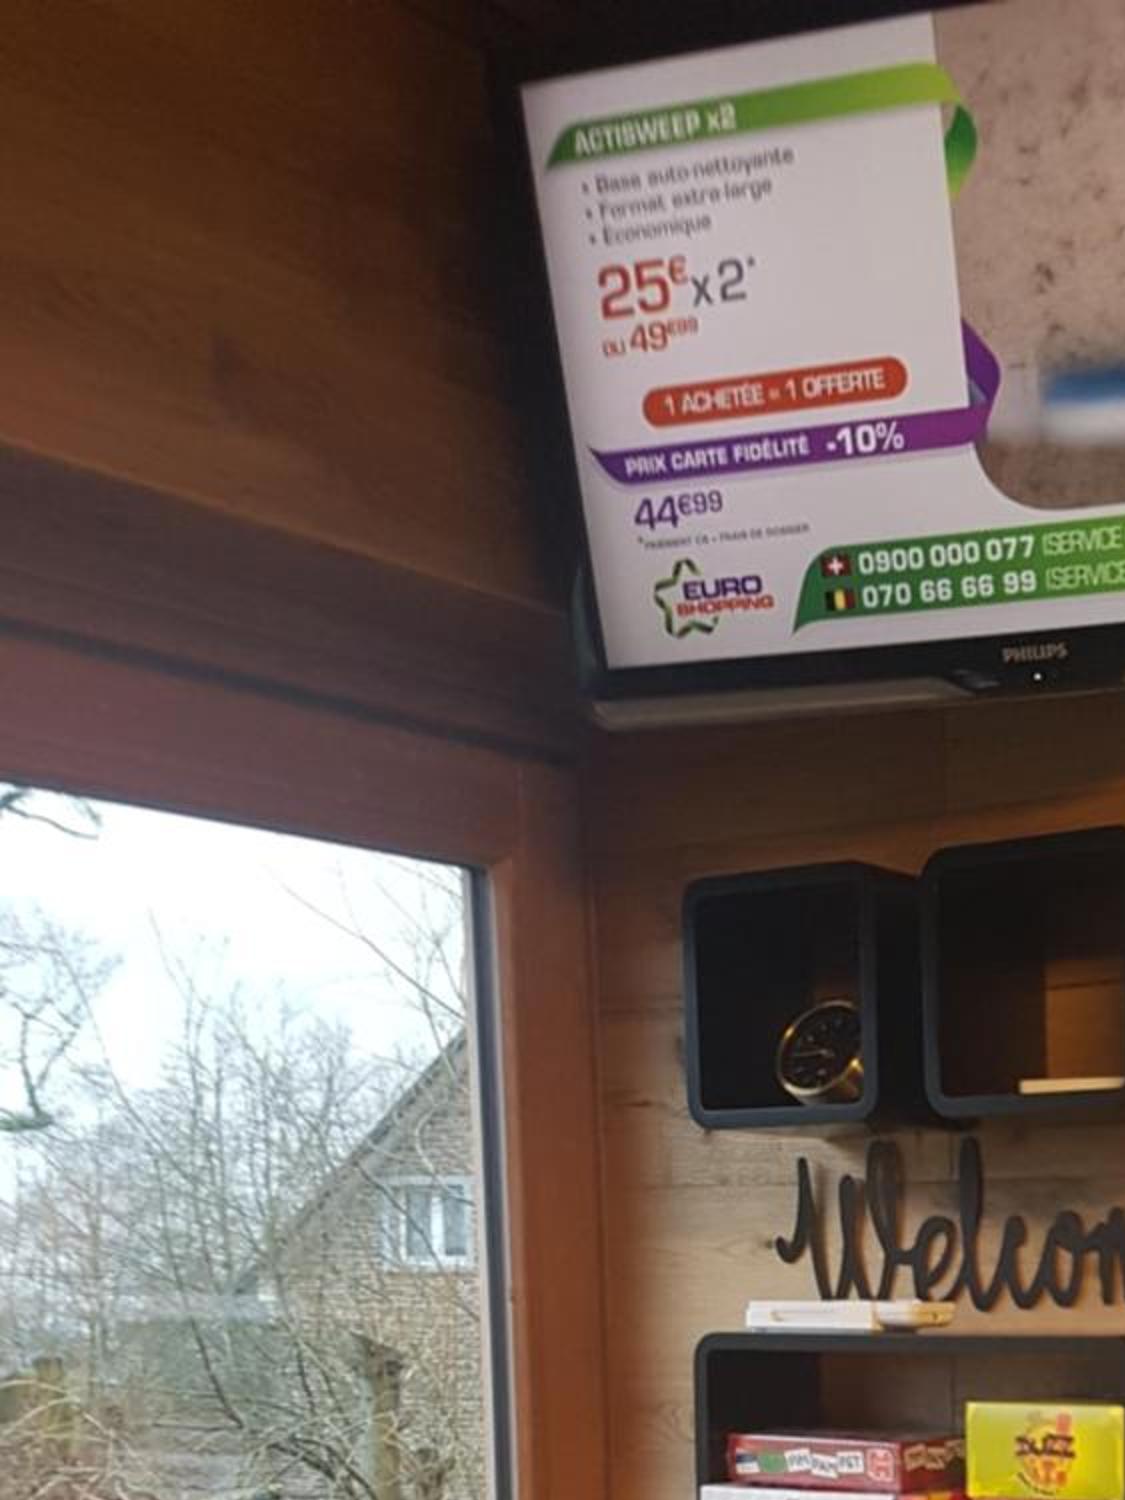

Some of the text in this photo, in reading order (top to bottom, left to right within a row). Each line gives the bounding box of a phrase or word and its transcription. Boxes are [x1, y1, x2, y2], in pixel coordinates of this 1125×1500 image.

[574, 101, 737, 157] ACTISWEEP x2
[595, 173, 642, 194] Base
[599, 195, 667, 220] Format
[665, 396, 674, 416] 1
[681, 384, 764, 414] ACHETÉE
[785, 377, 797, 400] 1
[803, 367, 886, 396] OFFERTE
[625, 454, 667, 477] PRIX
[671, 447, 729, 471] CARTE
[827, 421, 905, 455] -10%
[634, 489, 724, 532] 44€99
[858, 545, 924, 575] 0900
[929, 540, 981, 568] 000
[985, 535, 1035, 561] 077
[676, 595, 775, 617] SHOPPING
[682, 574, 764, 601] EURO
[862, 583, 912, 608] 070
[919, 578, 952, 602] 66
[961, 574, 994, 598] 66
[1003, 569, 1037, 594] 99
[1002, 643, 1068, 664] PHILIPS
